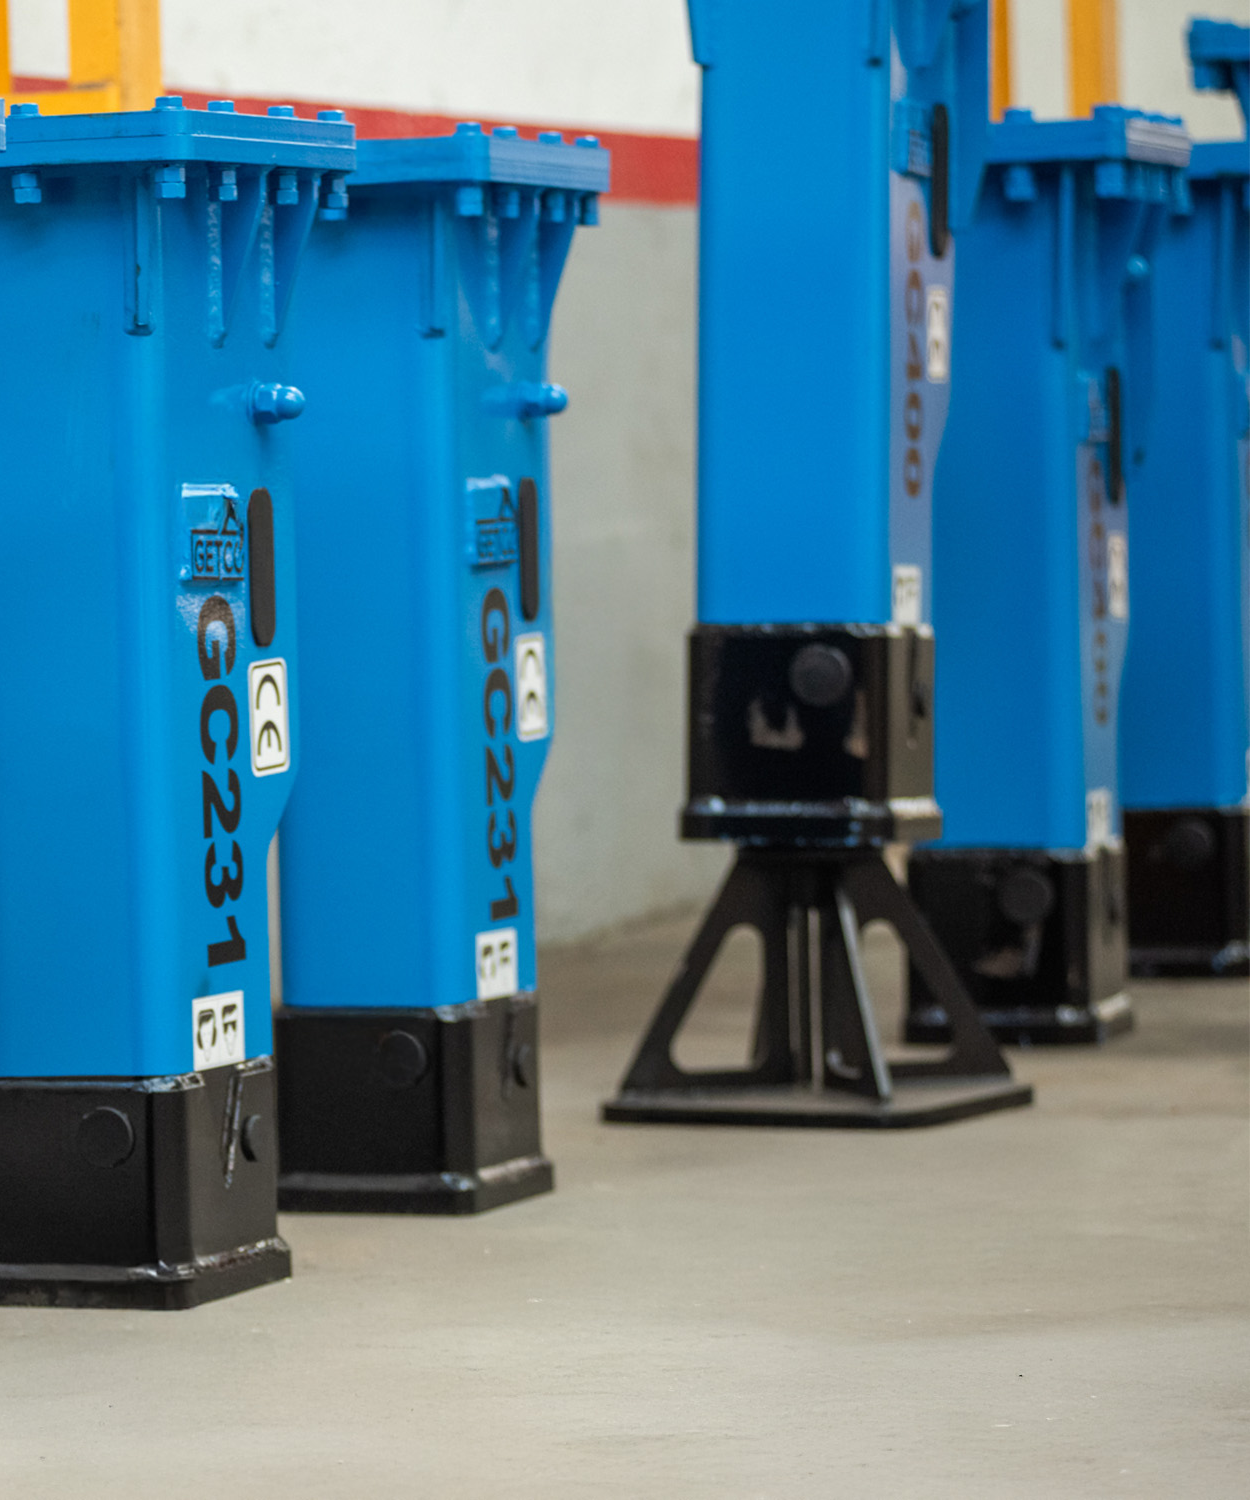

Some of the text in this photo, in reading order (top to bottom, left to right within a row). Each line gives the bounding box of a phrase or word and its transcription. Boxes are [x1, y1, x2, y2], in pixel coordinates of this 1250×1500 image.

[194, 539, 245, 573] GETCO
[197, 595, 247, 968] GC231
[255, 673, 283, 758] CE
[481, 587, 519, 922] GC231
